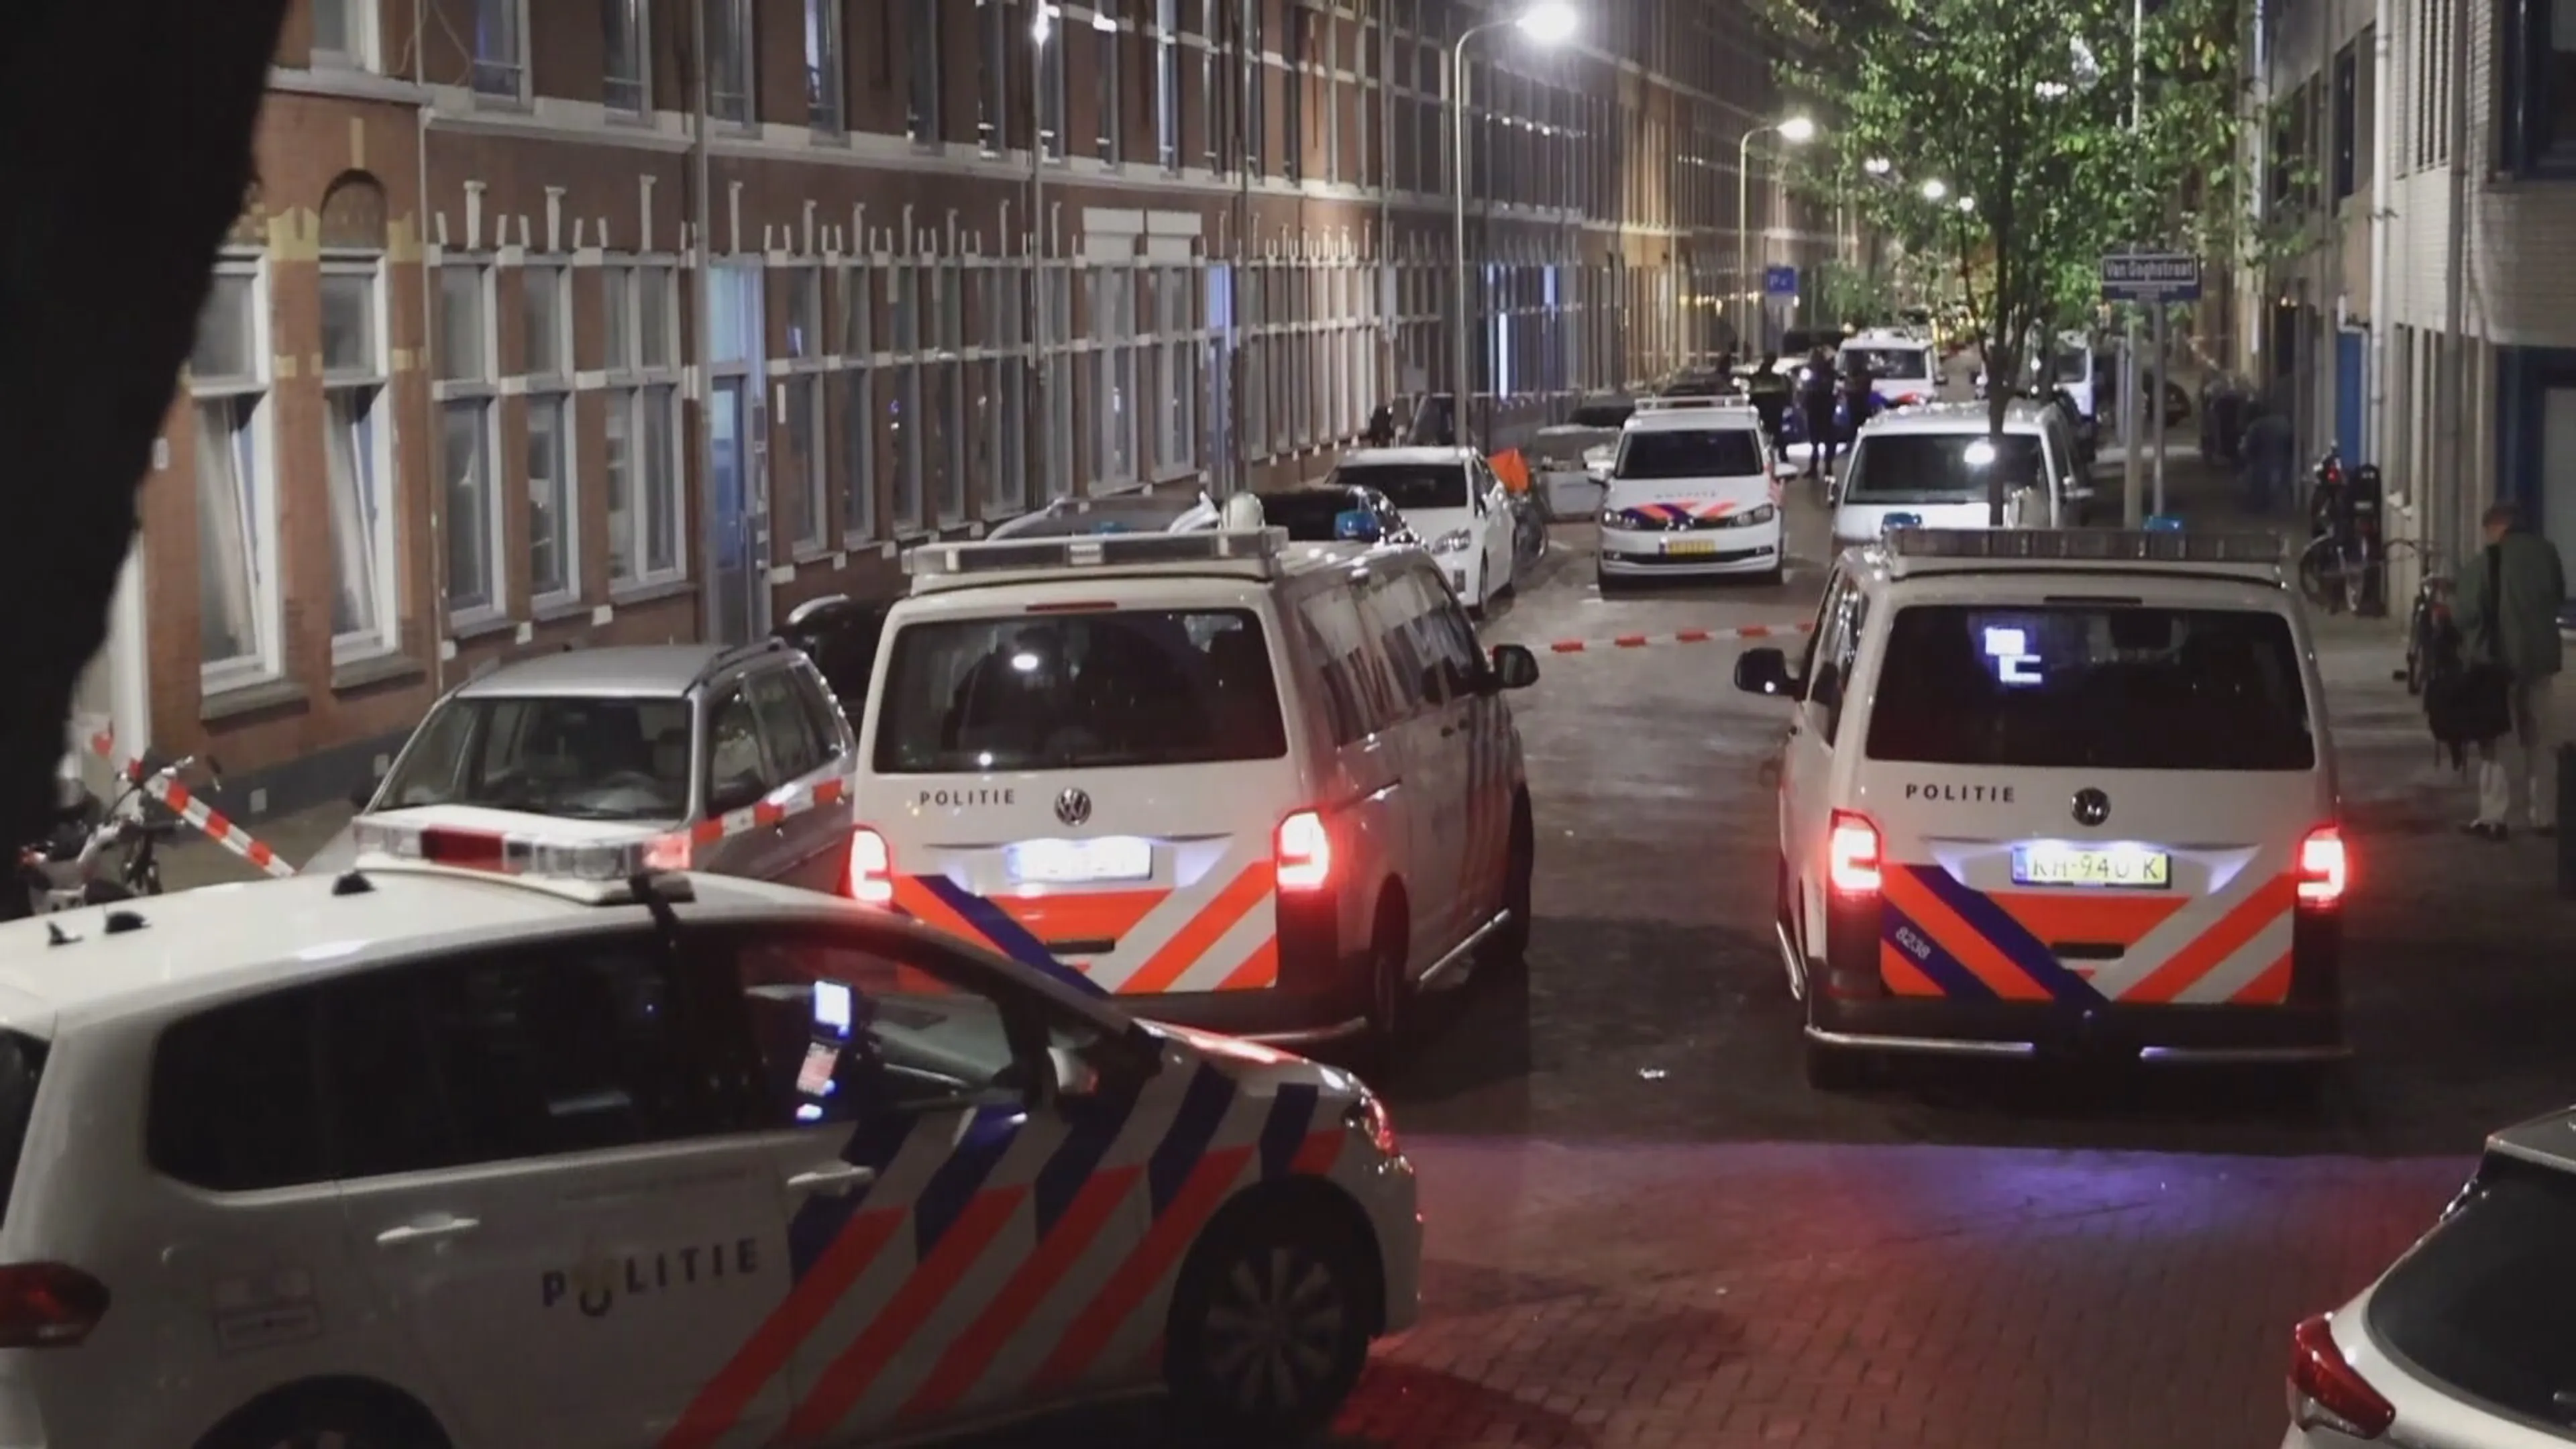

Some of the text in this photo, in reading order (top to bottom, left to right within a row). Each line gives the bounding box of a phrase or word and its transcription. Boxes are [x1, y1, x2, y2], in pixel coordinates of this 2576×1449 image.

[2106, 260, 2193, 281] Van Goghstraat
[920, 788, 1015, 805] POLITIE
[1906, 783, 2015, 802] POLITIE
[542, 1238, 758, 1318] POLITIE
